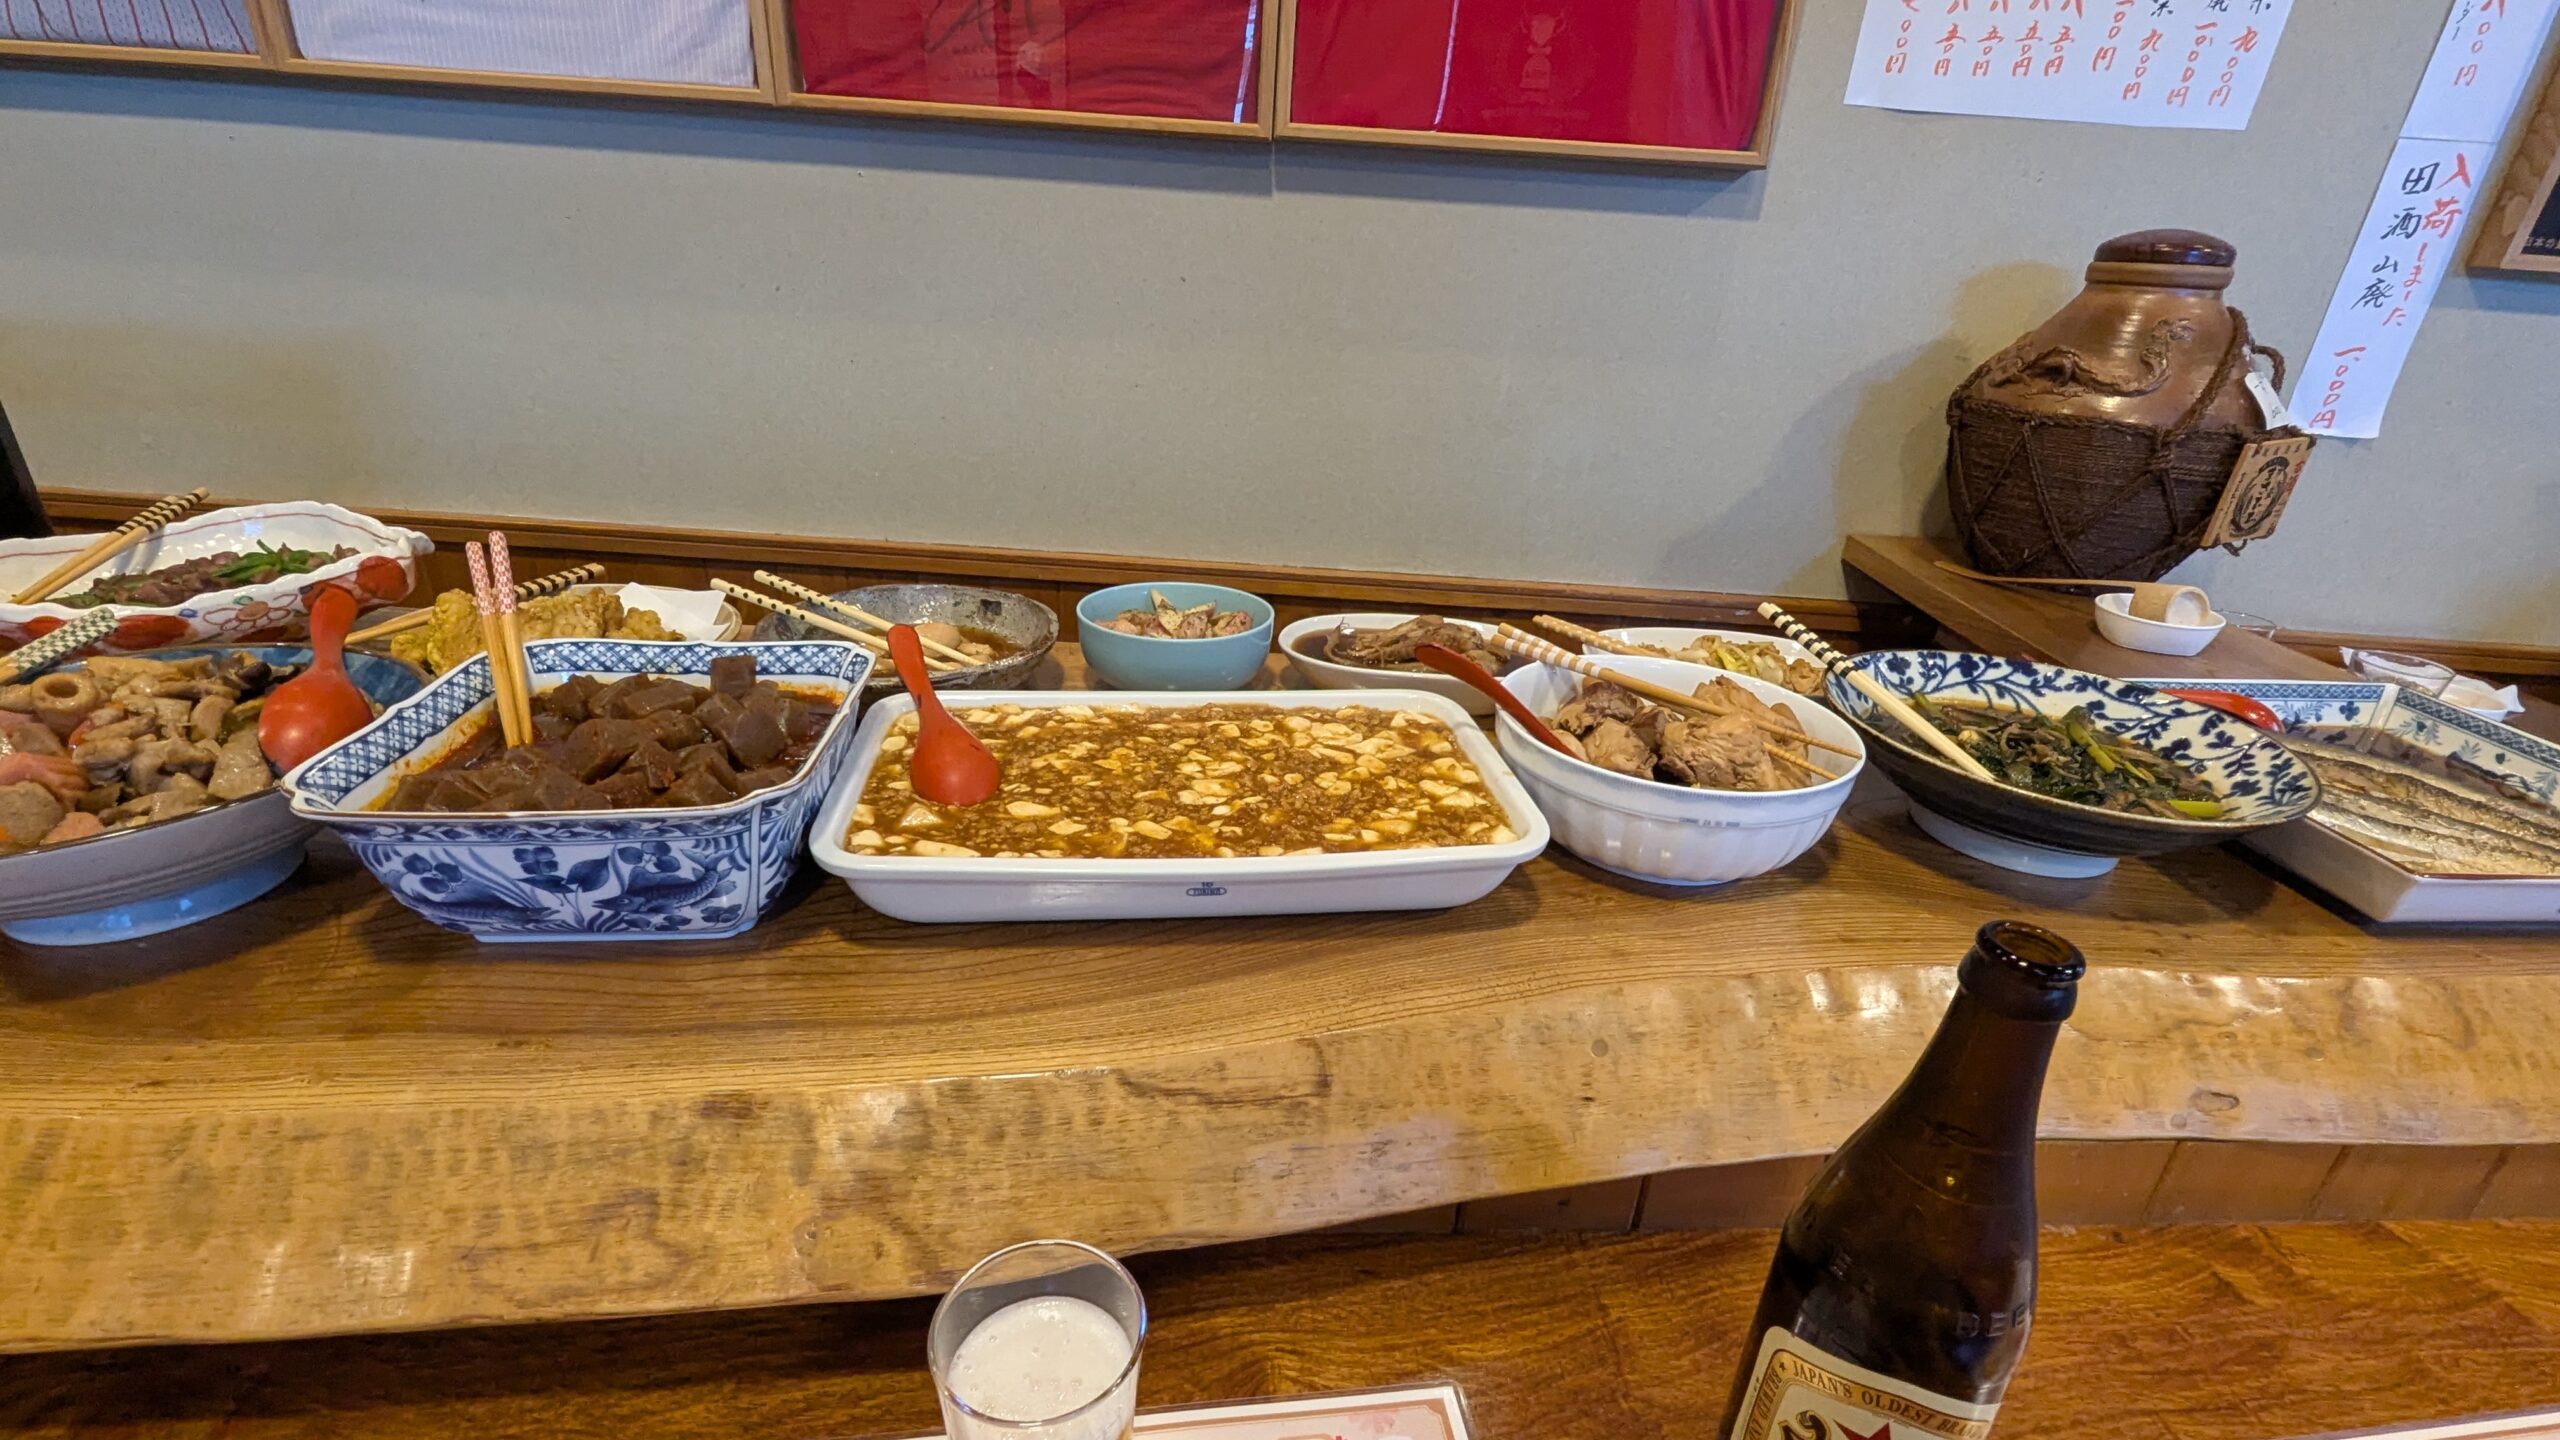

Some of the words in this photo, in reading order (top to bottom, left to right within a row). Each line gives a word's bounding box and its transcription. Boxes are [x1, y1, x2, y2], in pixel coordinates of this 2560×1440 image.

[2382, 152, 2471, 326] 入荷しました
[1792, 1360, 1853, 1399] JAPAN'S
[1861, 1390, 1934, 1425] OLDEST
